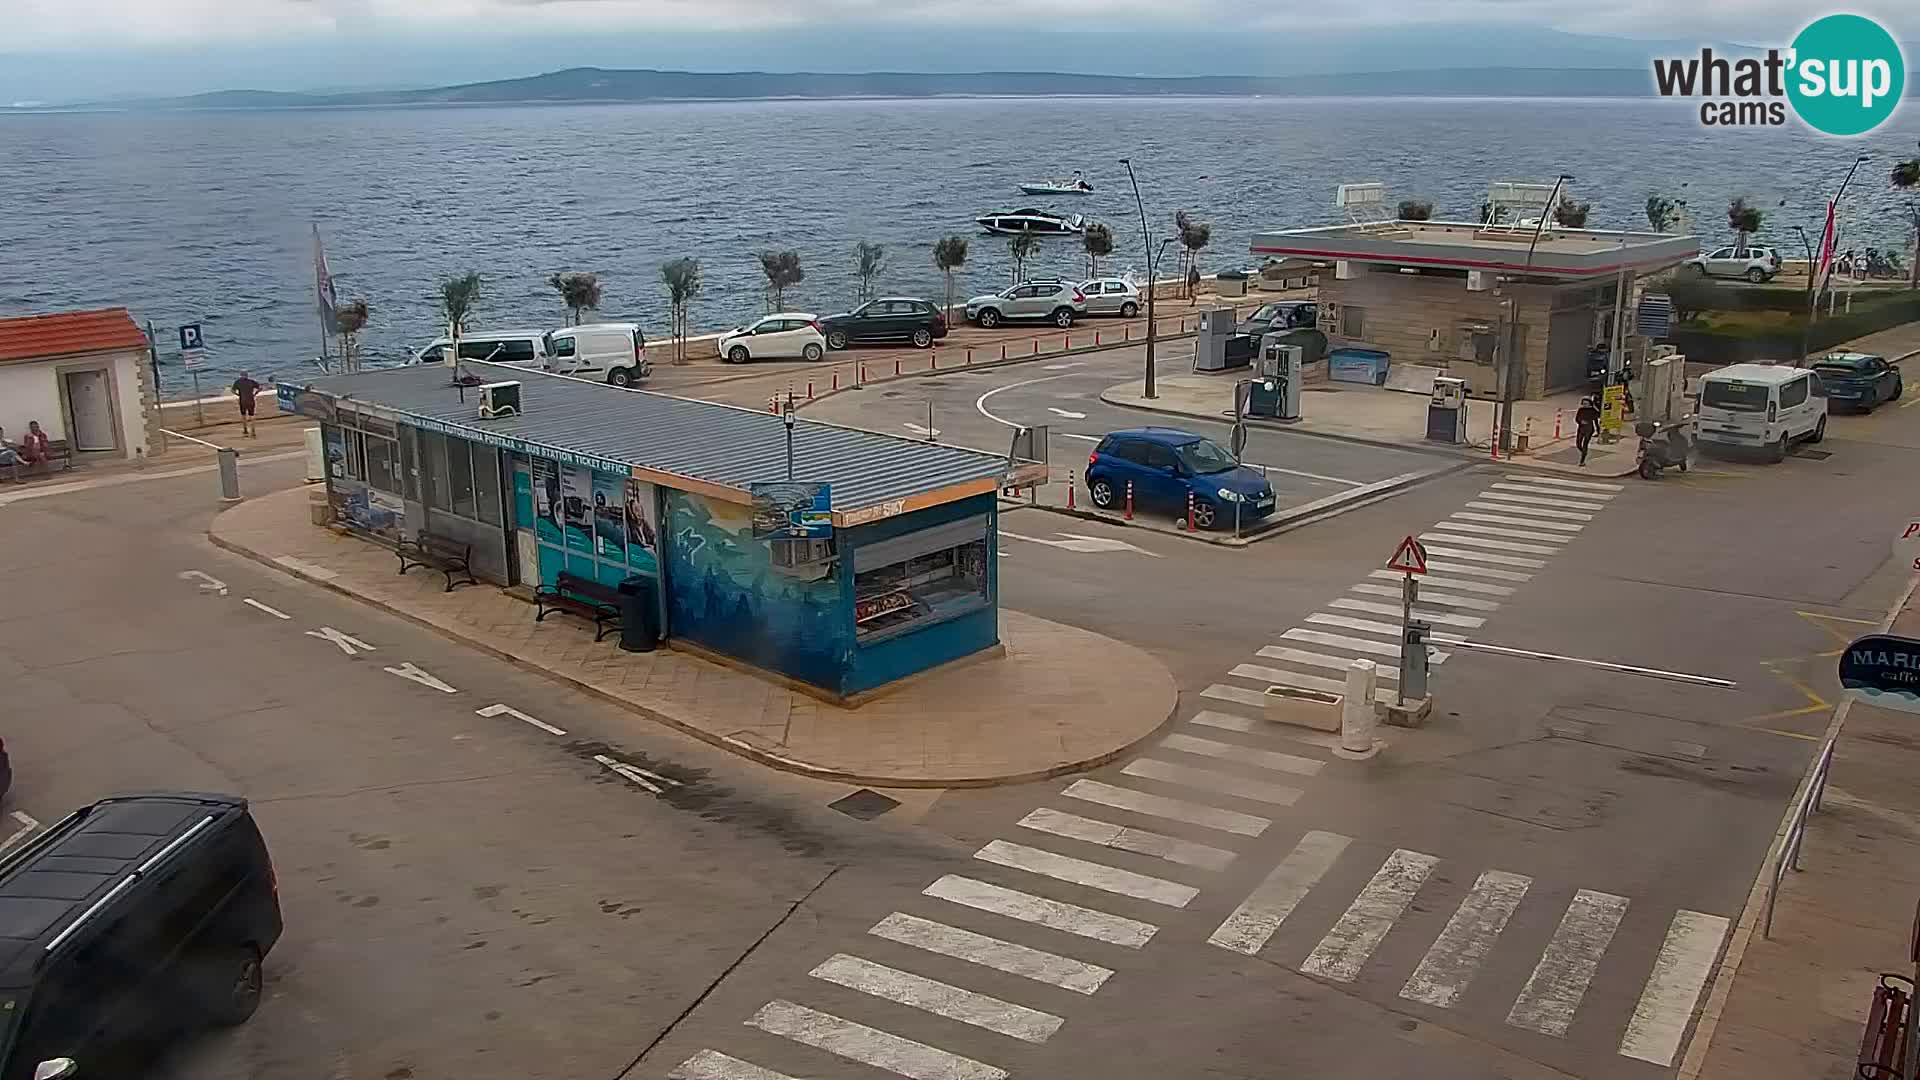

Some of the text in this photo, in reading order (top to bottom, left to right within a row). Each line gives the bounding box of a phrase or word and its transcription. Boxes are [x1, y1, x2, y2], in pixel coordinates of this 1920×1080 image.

[184, 328, 196, 346] P
[485, 434, 515, 450] POSTAJA
[525, 444, 540, 456] BUS
[541, 447, 573, 463] STATION
[574, 454, 600, 469] TICKET
[601, 461, 628, 475] OFFICE
[1901, 522, 1920, 539] P
[1852, 650, 1920, 670] MARI
